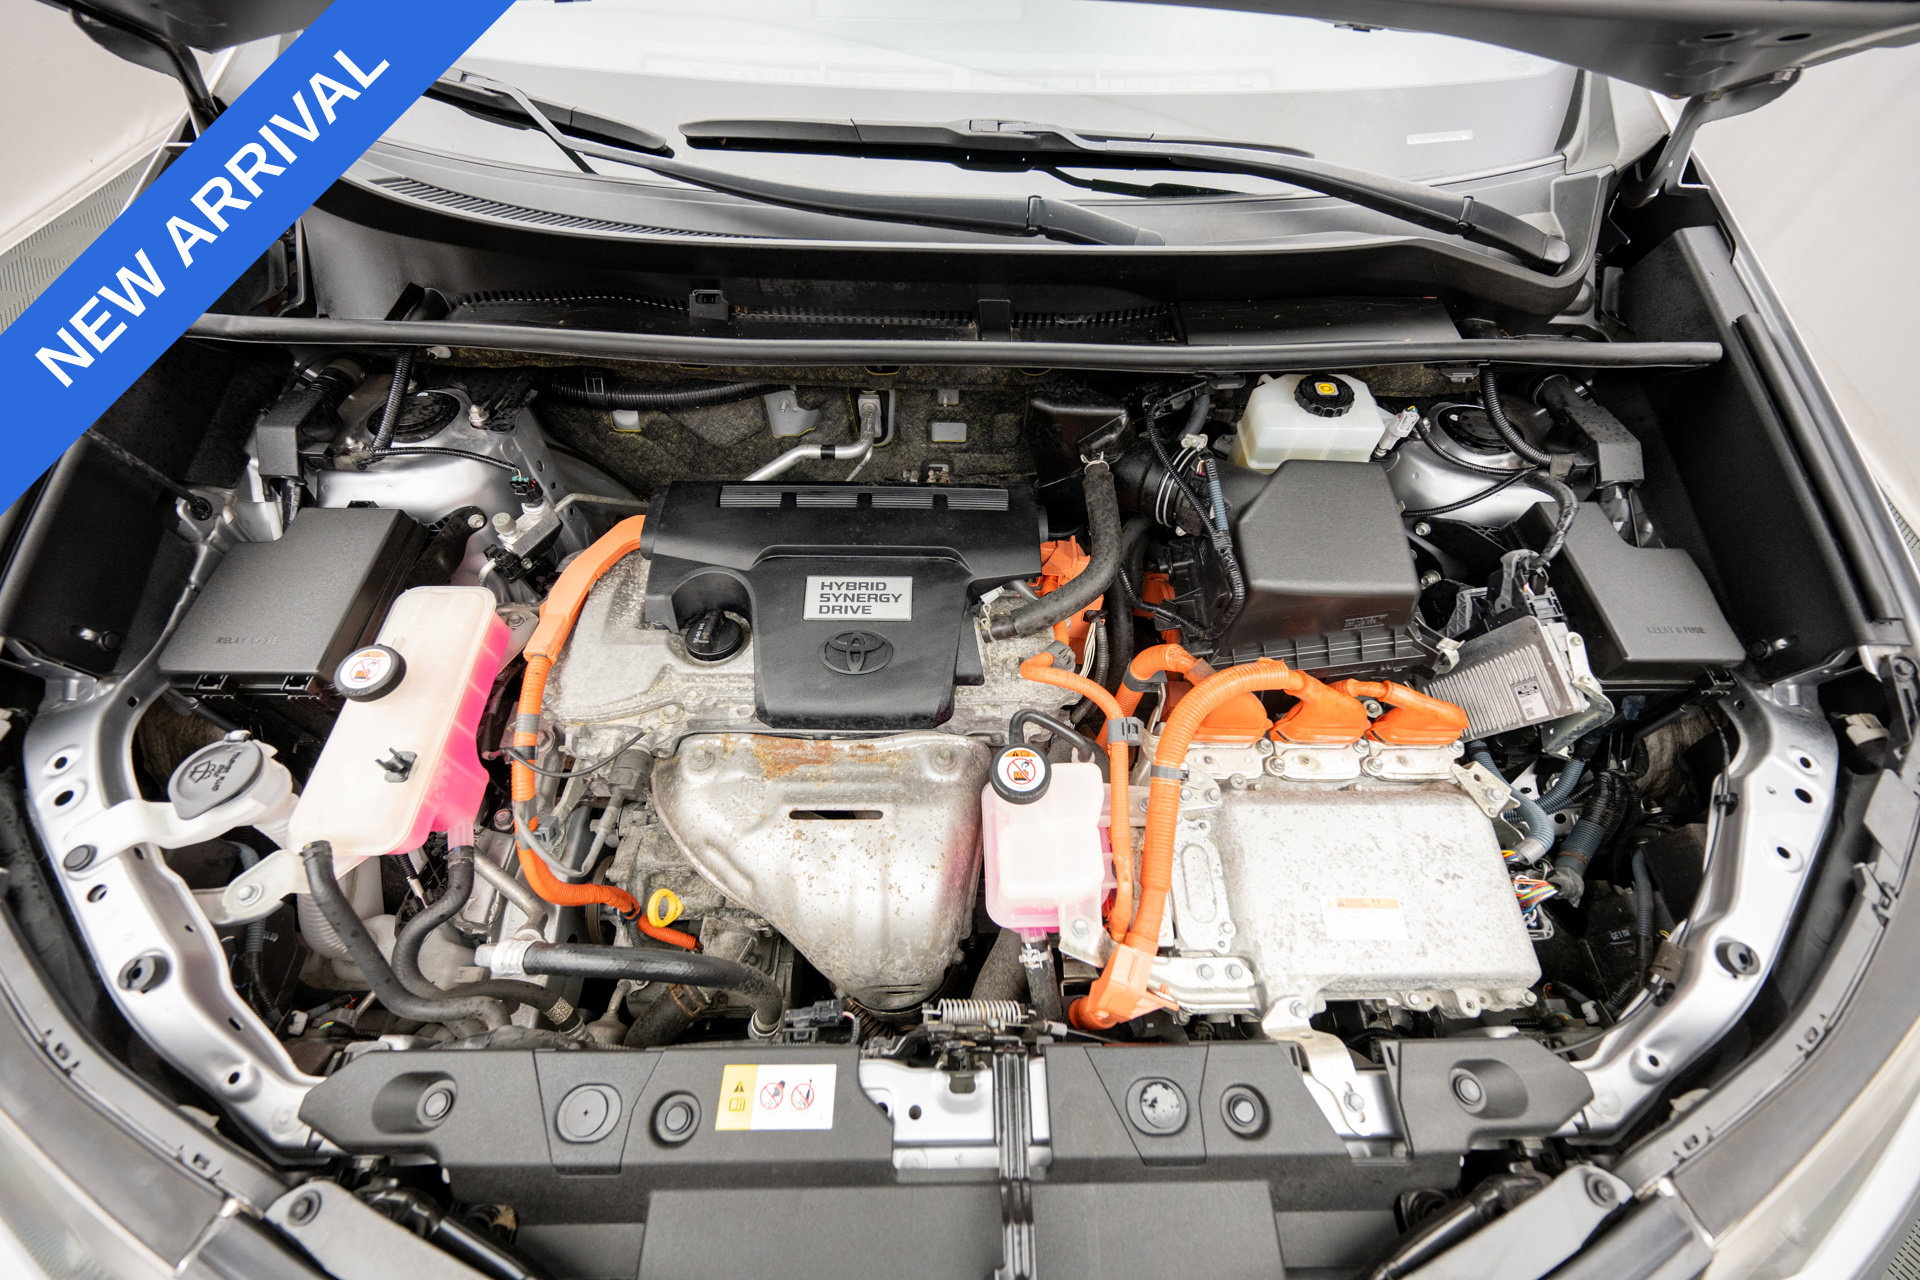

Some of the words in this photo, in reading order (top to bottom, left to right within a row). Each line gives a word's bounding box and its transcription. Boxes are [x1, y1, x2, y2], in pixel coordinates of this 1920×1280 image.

[820, 581, 887, 591] HYBRID
[819, 593, 902, 603] SYNERGY
[818, 605, 872, 614] DRIVE
